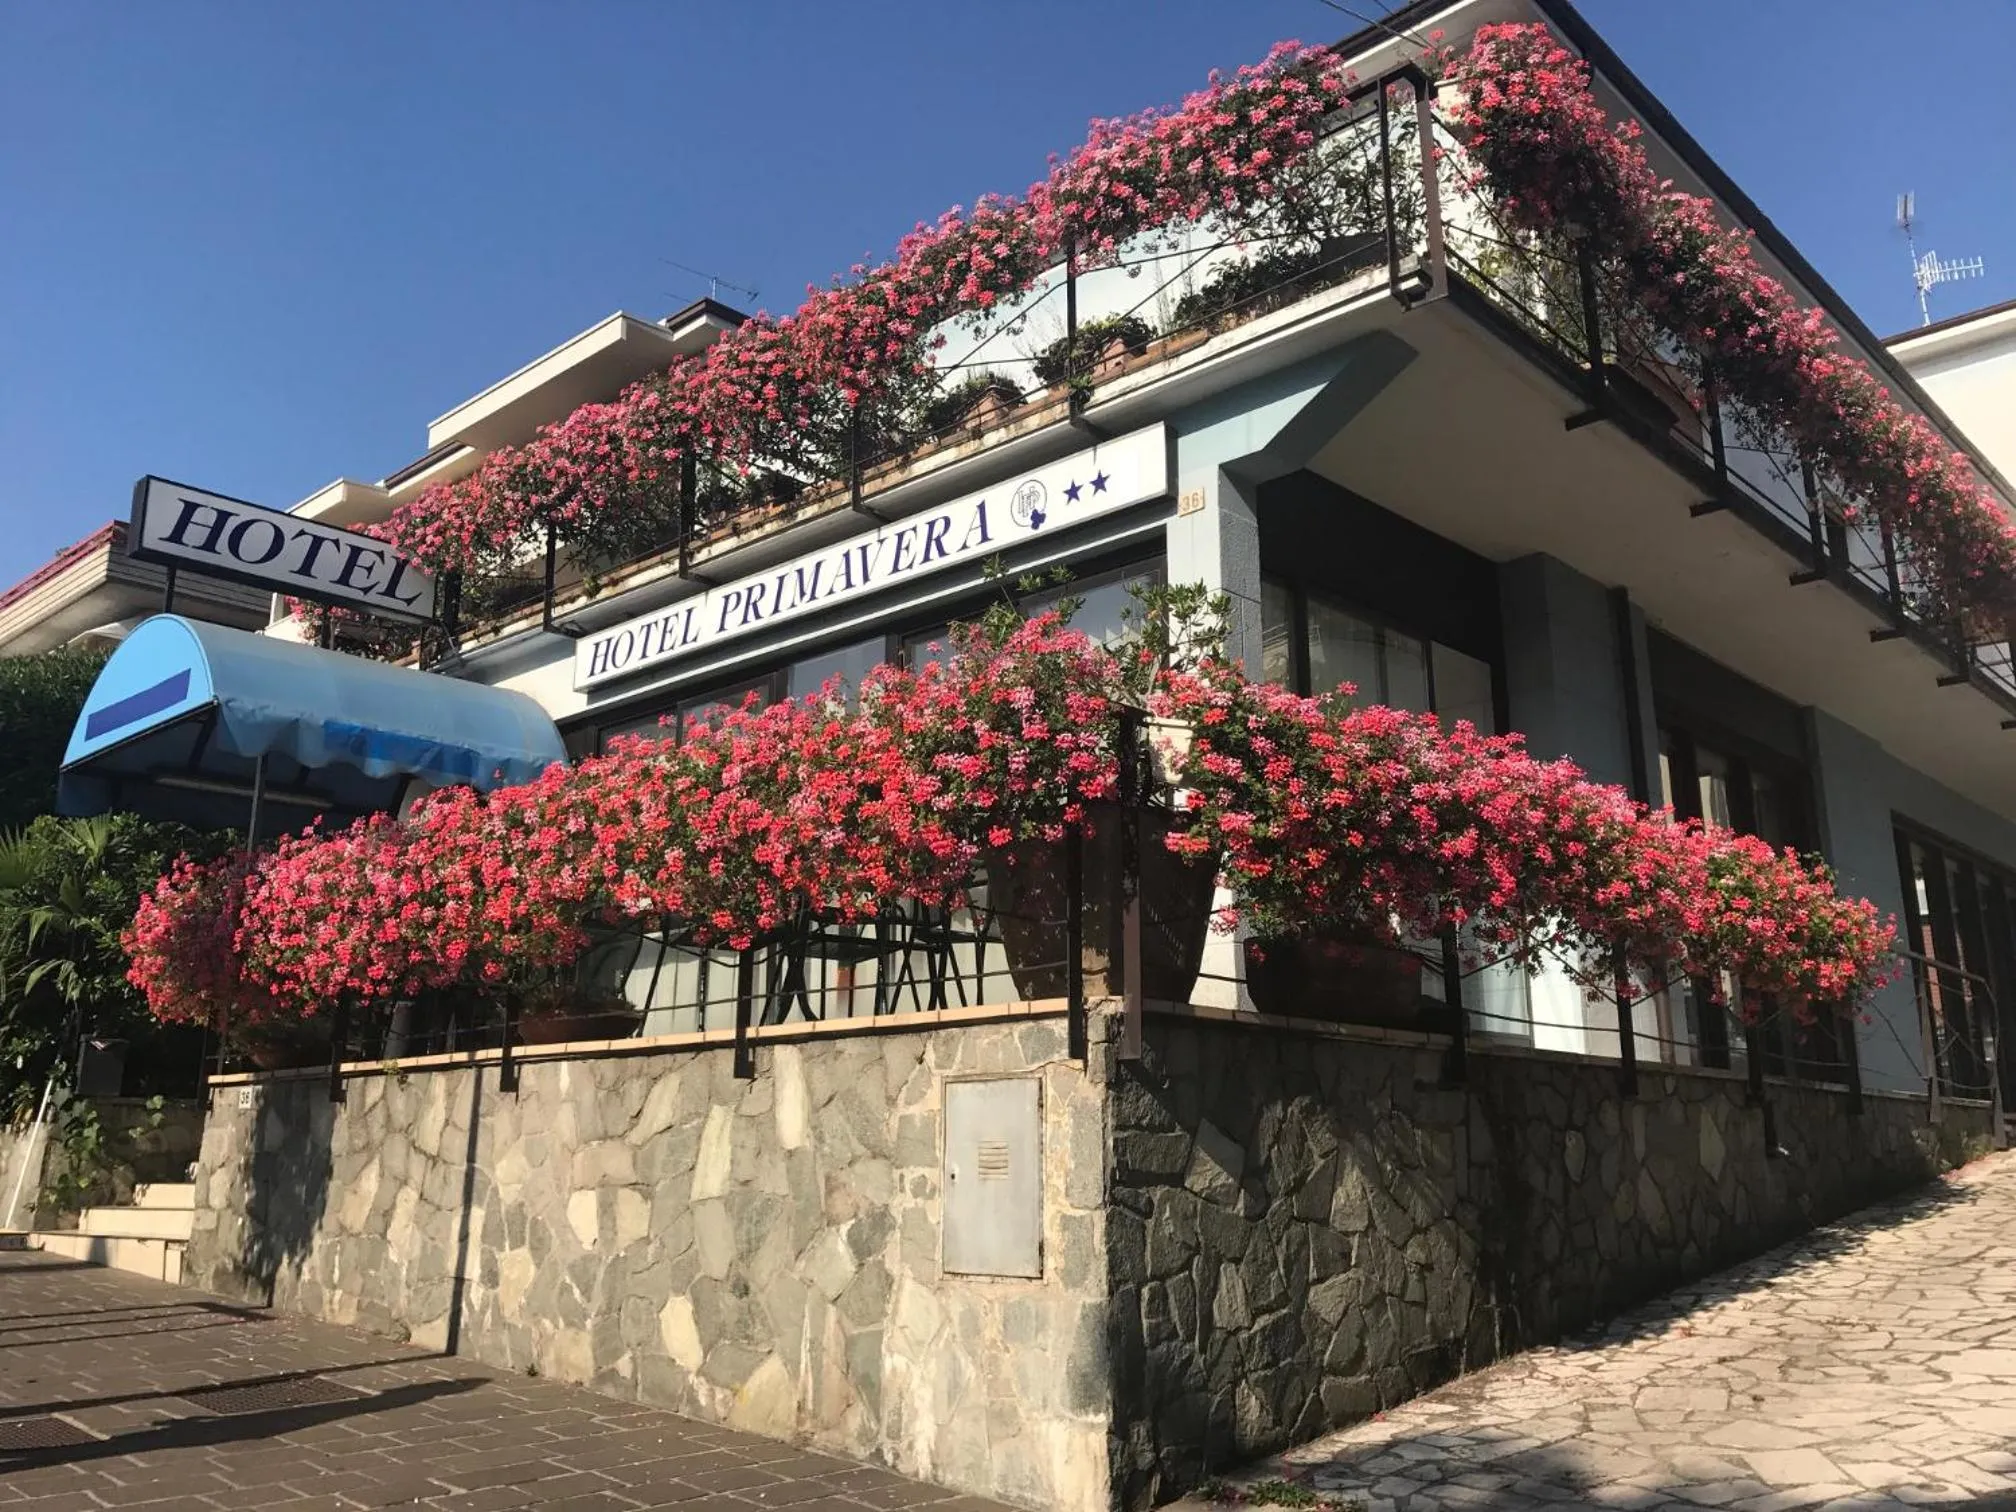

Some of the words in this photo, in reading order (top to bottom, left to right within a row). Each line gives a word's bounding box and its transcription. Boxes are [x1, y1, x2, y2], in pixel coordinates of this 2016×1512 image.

[159, 498, 423, 607] HOTEL
[1181, 491, 1200, 512] 36
[588, 606, 701, 679] HOTEL
[715, 499, 994, 634] PRIMAVERA
